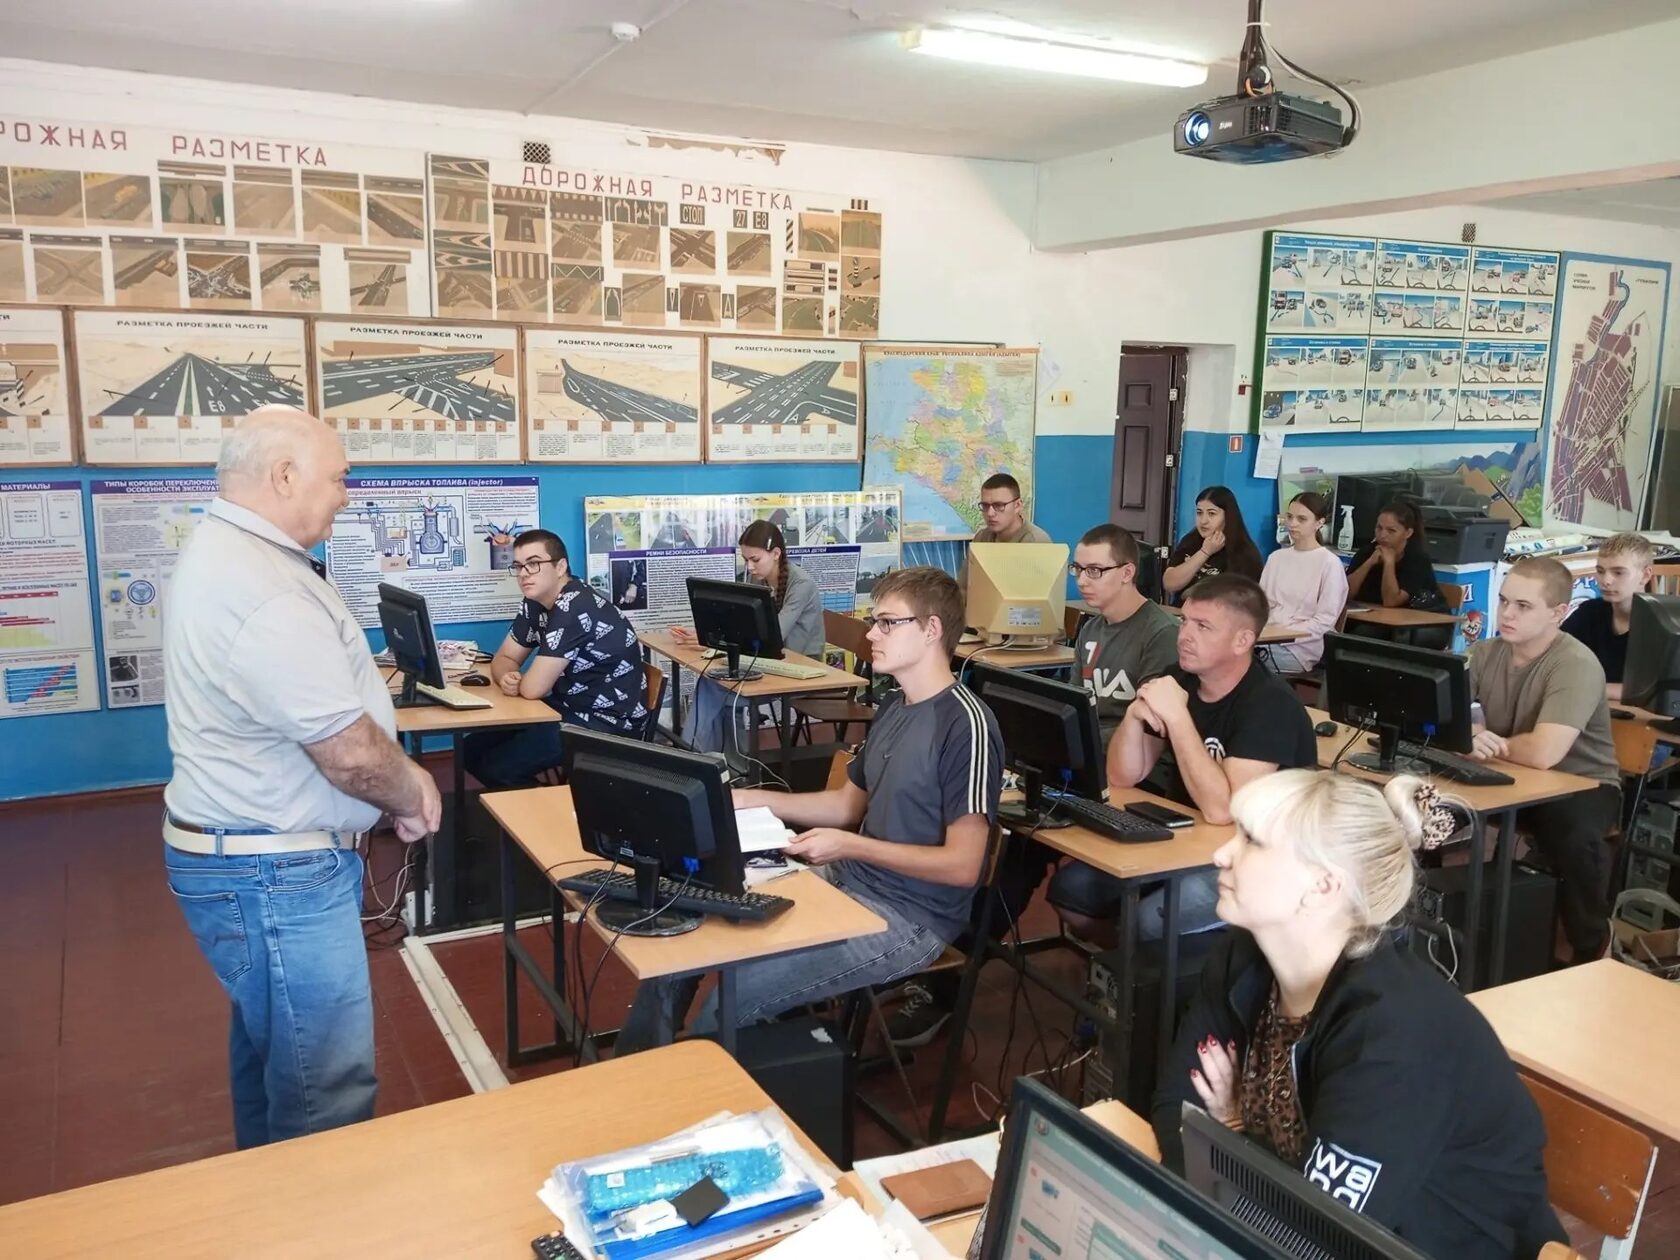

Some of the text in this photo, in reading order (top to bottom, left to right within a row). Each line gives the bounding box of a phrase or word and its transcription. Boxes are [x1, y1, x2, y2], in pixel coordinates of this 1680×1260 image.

[171, 134, 329, 167] РАЗМЕТКА
[522, 164, 793, 211] ДОРОЖНАЯ РАЗМЕТКА
[682, 205, 705, 224] СТОП
[116, 319, 173, 328] РАЗМЕТКА
[234, 322, 269, 330] ЧАСТИ
[349, 326, 400, 335] РАЗМЕТКА
[558, 338, 601, 347] РАЗМЕТКА
[208, 400, 226, 413] E8
[0, 483, 51, 491] МАТЕРИАЛЫ
[104, 480, 128, 488] ТИПЫ
[165, 479, 218, 487] ПЕРЕКЛЮЧЕН
[360, 479, 504, 487] СХЕМА ВПРЫСКА ТОПЛИВА (injector)
[646, 548, 708, 557] РЕМНИ БЕЗОПАСНОСТИ
[785, 547, 811, 555] ЕРЕВОЗКА
